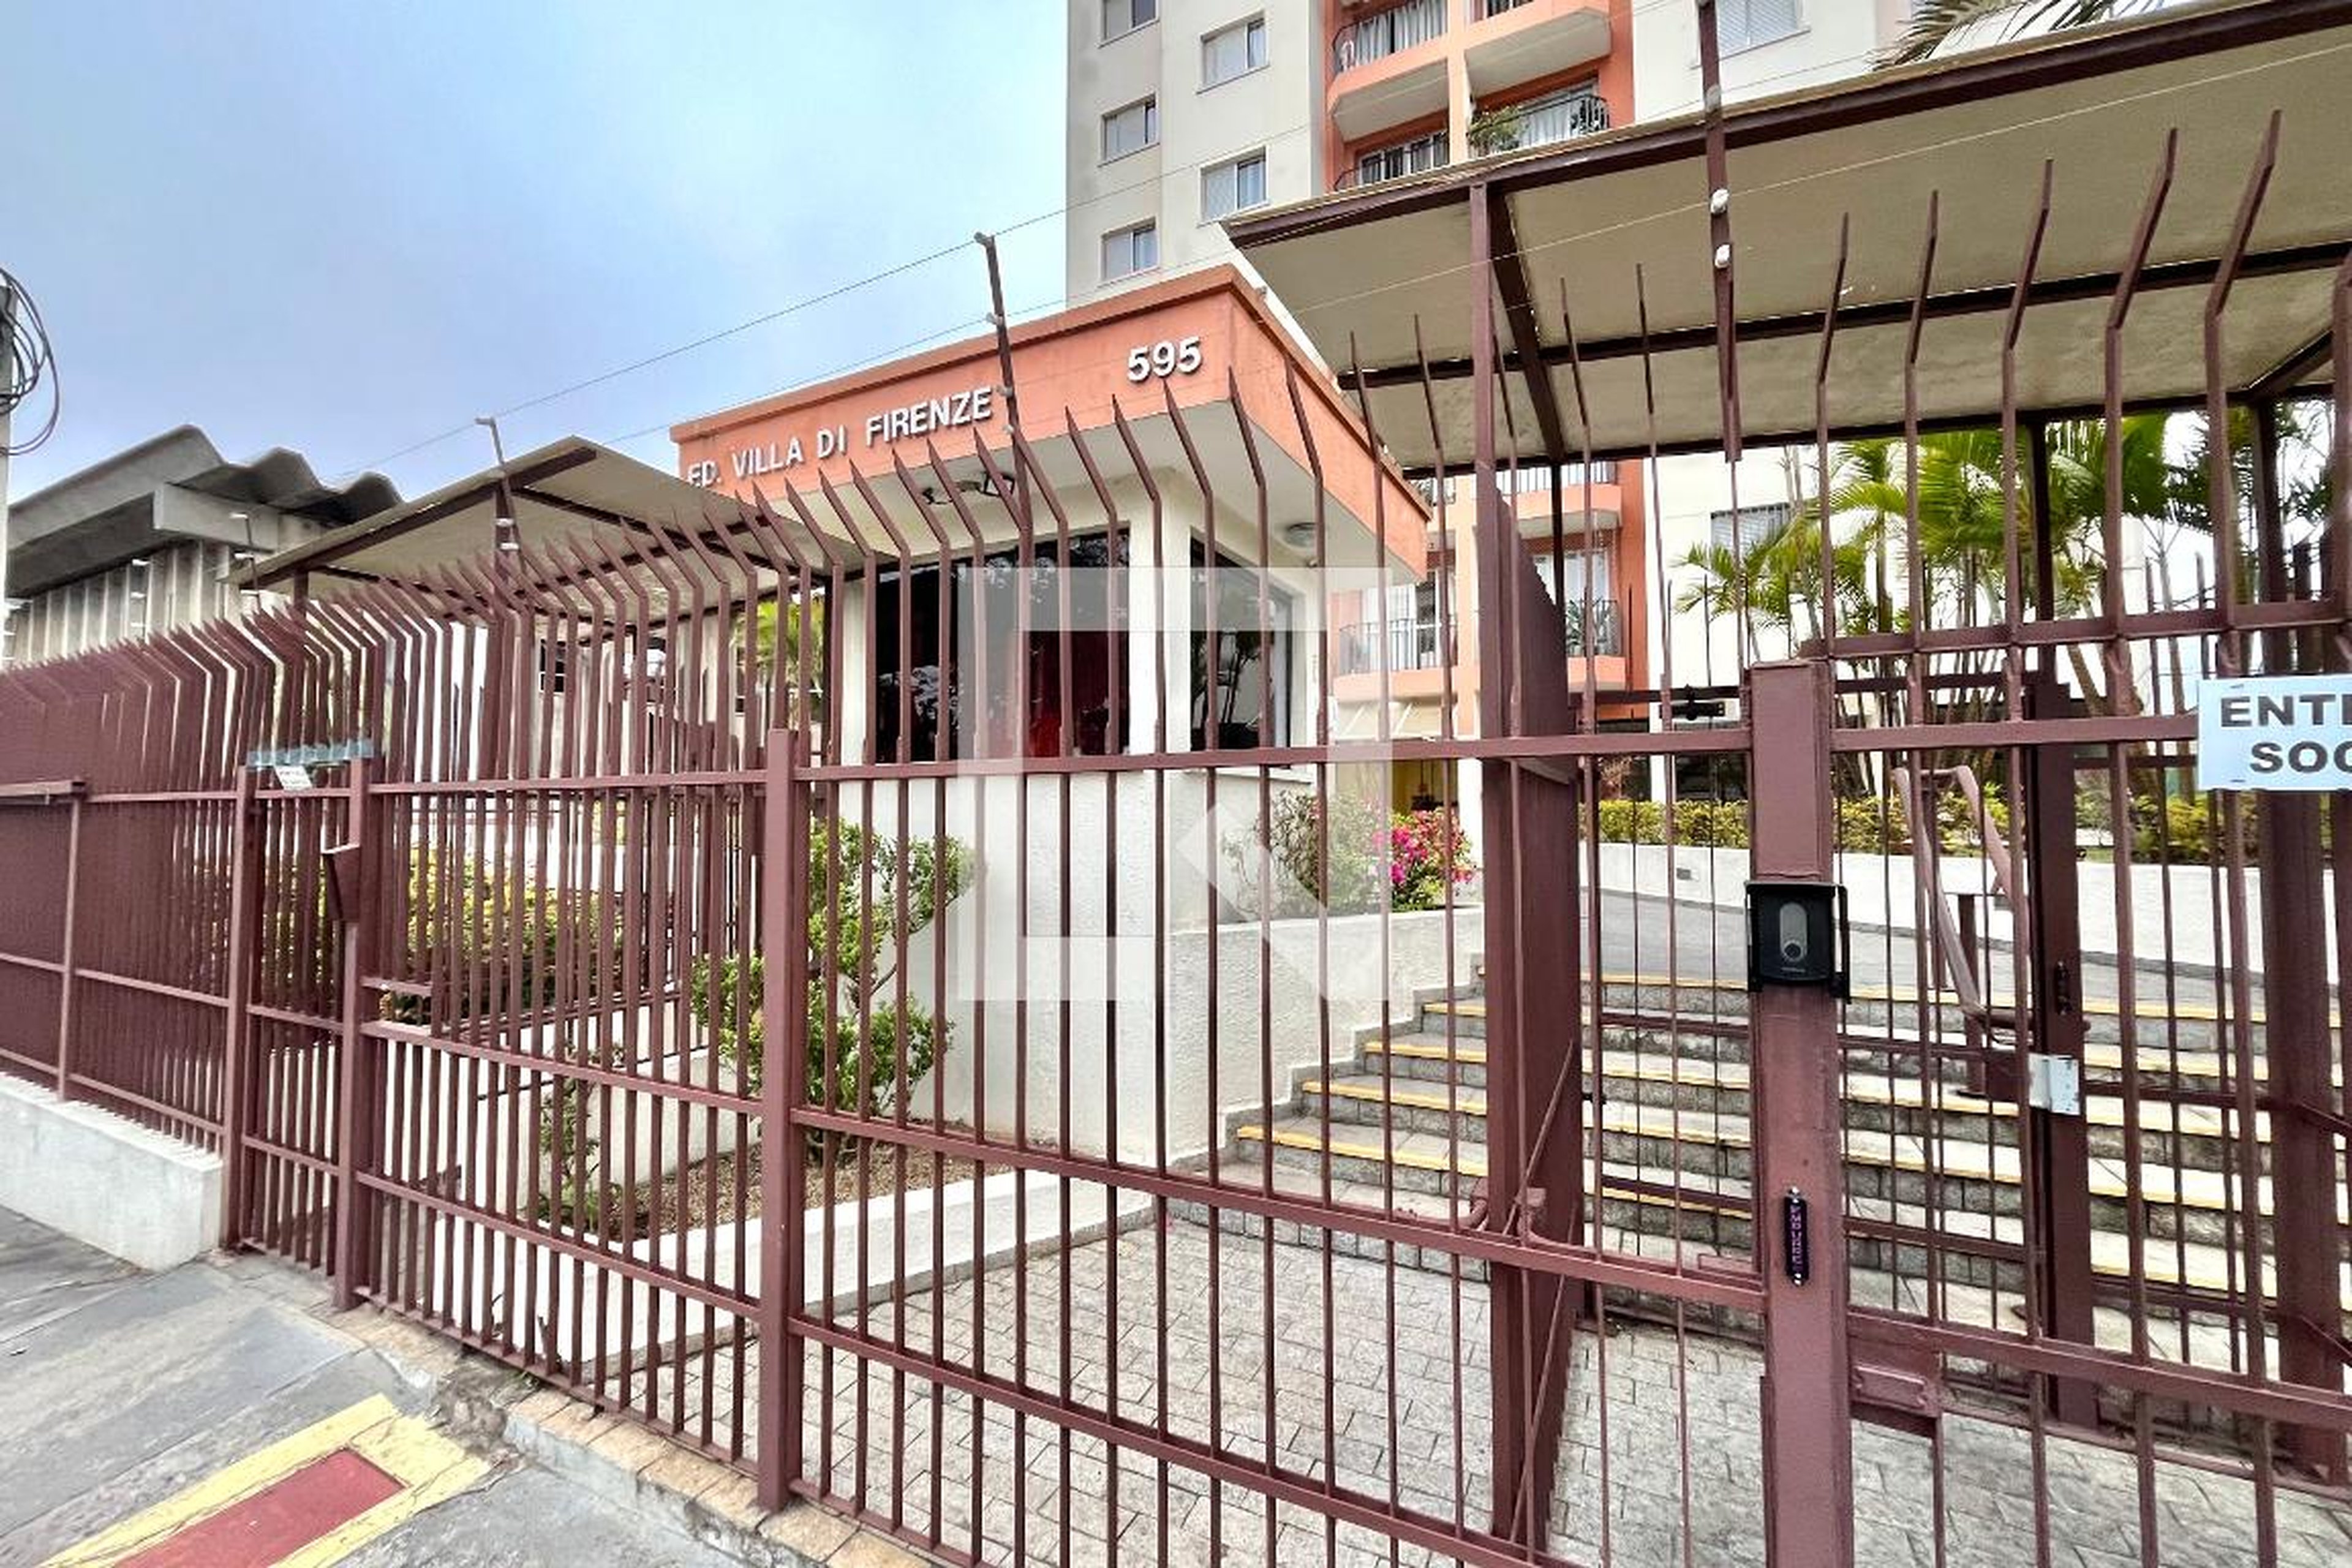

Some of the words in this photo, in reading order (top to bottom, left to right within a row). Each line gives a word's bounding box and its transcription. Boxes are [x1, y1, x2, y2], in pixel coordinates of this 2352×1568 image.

[1127, 336, 1202, 382] 595
[731, 437, 805, 478] VILLA
[816, 424, 846, 459] DI
[865, 385, 992, 447] FIRENZE
